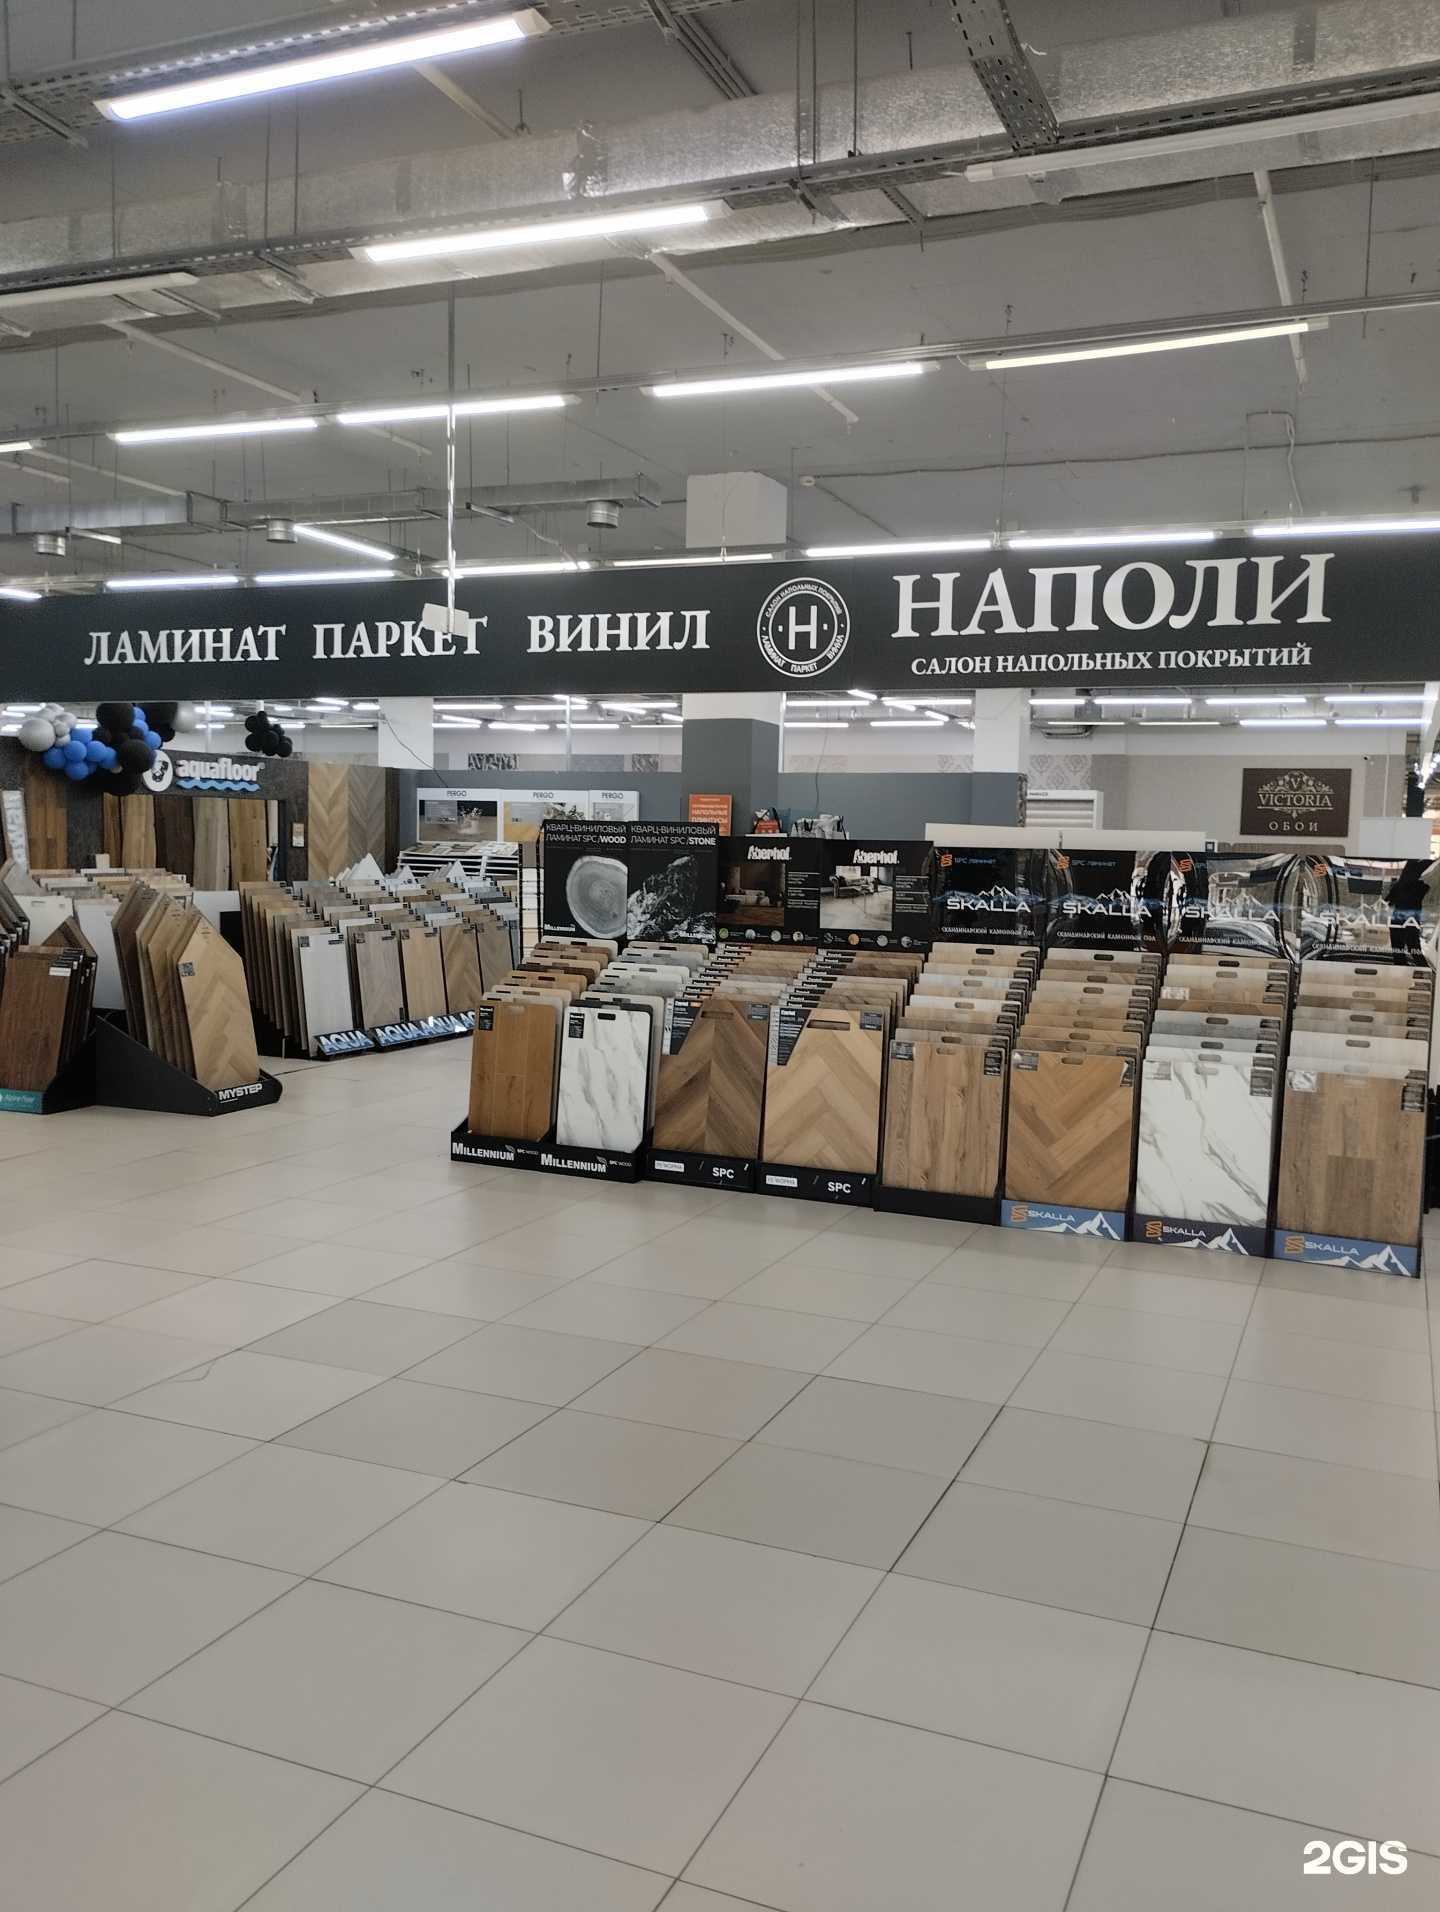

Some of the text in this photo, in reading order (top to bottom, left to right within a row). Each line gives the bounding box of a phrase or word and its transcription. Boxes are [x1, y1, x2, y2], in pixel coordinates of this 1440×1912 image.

[891, 553, 1335, 638] НАПОЛИ
[788, 605, 817, 650] Н
[84, 610, 710, 666] ЛАМИНАТ ПАРКЕТ ВИНИЛ
[911, 642, 1312, 675] САЛОН НАПОЛЬНЫХ ПОКРЫТИЙ
[790, 662, 818, 673] ПАРКЕТ
[176, 758, 259, 781] aquafloor
[602, 792, 623, 800] PERGO
[1259, 794, 1332, 807] VICTORIA
[546, 824, 627, 833] КВАРЦ-ВИНИЛОВЫЙ
[631, 824, 716, 835] КВАРЦ-ВИНИЛОВЫЙ
[1269, 821, 1318, 832] ОБОИ
[631, 836, 669, 844] ЛАМИНАТ
[671, 837, 685, 845] SPC
[946, 898, 1031, 913] SKALLA
[1063, 901, 1152, 917] SKALLA
[1184, 904, 1280, 922] SKALLA
[1319, 911, 1421, 929] SKALLA
[319, 1030, 374, 1052] AQUA
[375, 1022, 421, 1044] AQUA
[419, 1015, 461, 1036] AQUA
[218, 1083, 263, 1101] MYSTEP
[712, 1167, 734, 1179] SPC
[827, 1181, 851, 1194] SPC
[1028, 1211, 1076, 1222] SKALLA
[1163, 1226, 1206, 1239] SKALLA
[1305, 1241, 1361, 1256] SKALLA
